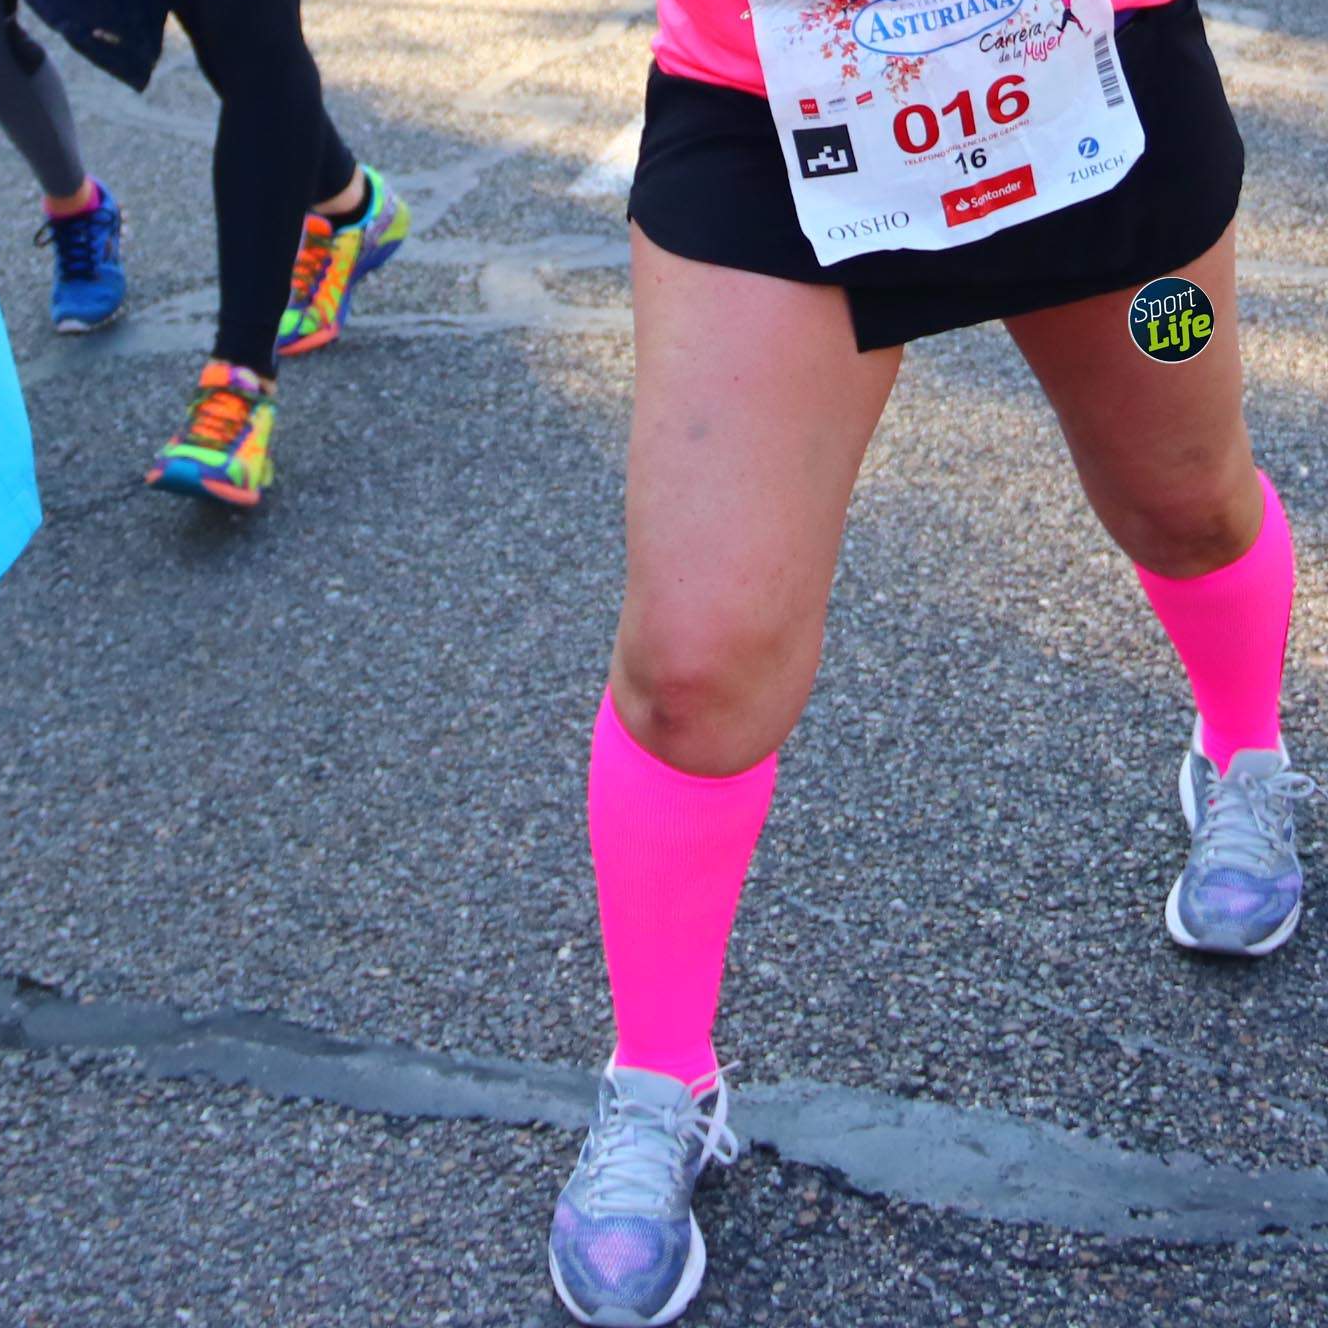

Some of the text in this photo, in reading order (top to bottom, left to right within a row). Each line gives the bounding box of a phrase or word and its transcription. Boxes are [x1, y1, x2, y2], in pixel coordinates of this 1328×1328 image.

[979, 21, 1043, 53] Carrera
[998, 50, 1010, 63] de
[1022, 32, 1064, 67] Mujer
[892, 73, 1031, 155] 016
[954, 148, 987, 175] 16
[1068, 153, 1124, 184] ZURICH
[969, 179, 1023, 209] Santander
[827, 210, 910, 242] OYSHO
